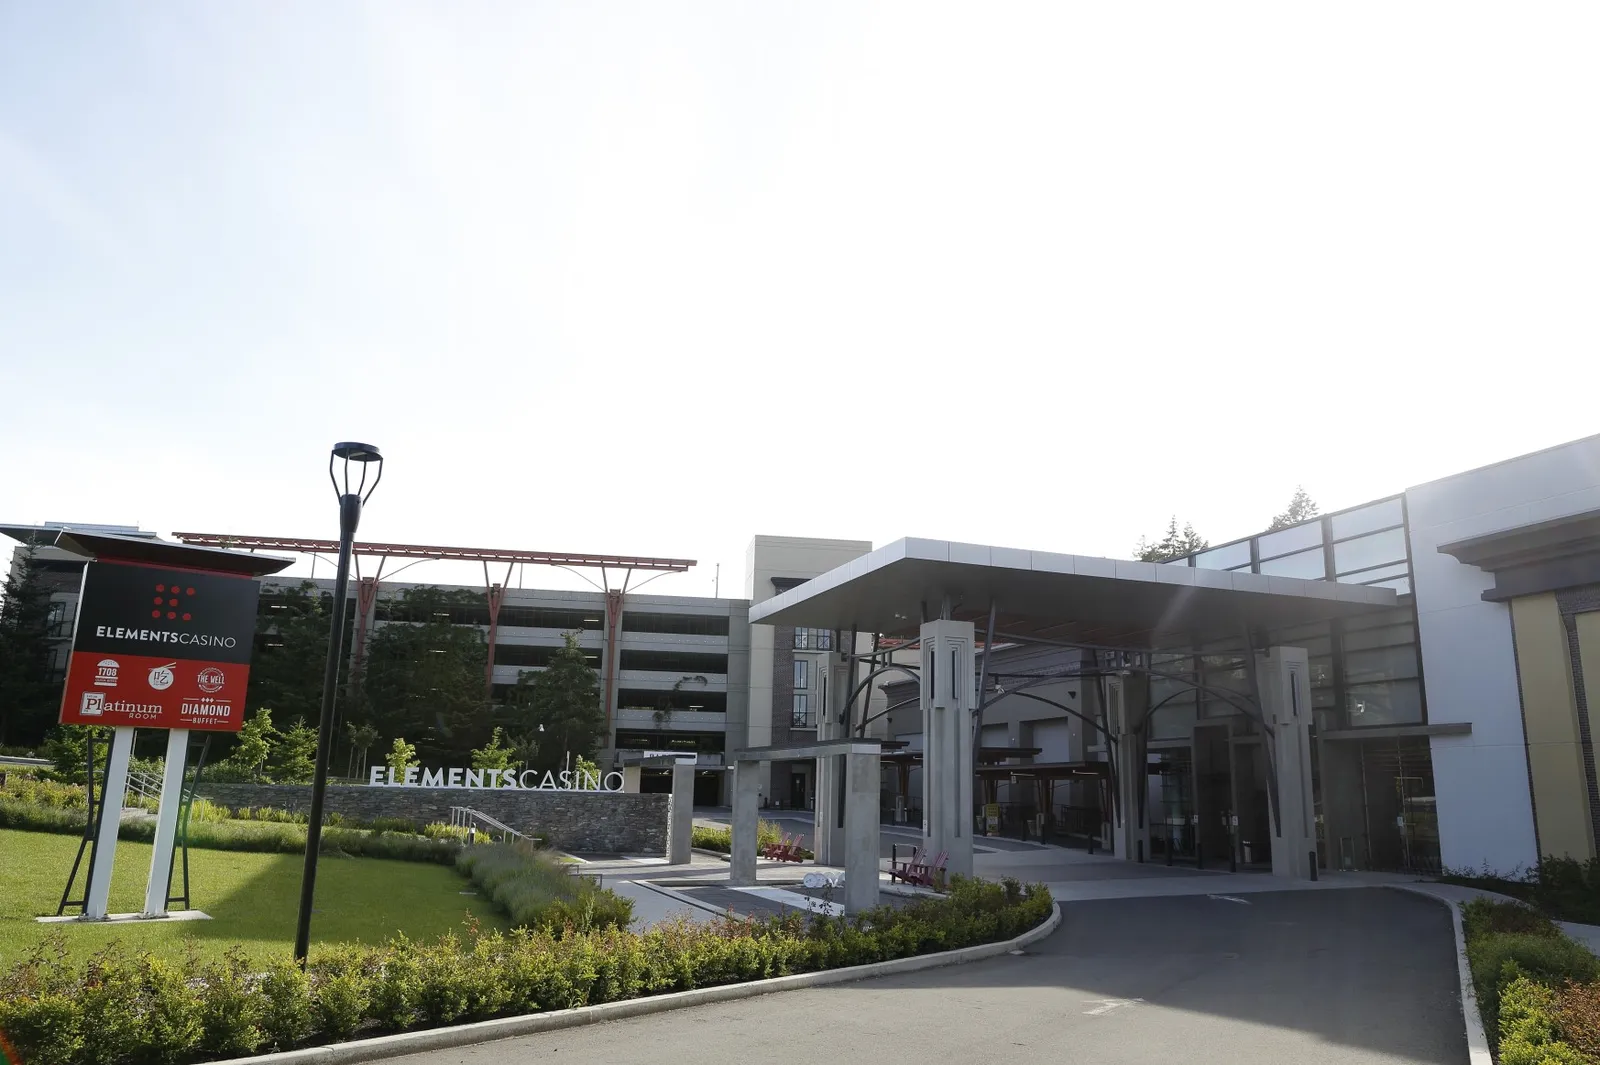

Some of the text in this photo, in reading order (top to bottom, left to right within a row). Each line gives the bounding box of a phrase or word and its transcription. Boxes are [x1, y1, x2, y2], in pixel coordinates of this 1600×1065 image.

[98, 667, 117, 677] 1708
[197, 674, 225, 685] THE WELL
[85, 698, 163, 714] Platinum
[181, 703, 231, 717] DIAMOND
[128, 712, 157, 720] ROOM
[192, 717, 218, 725] BUFFET
